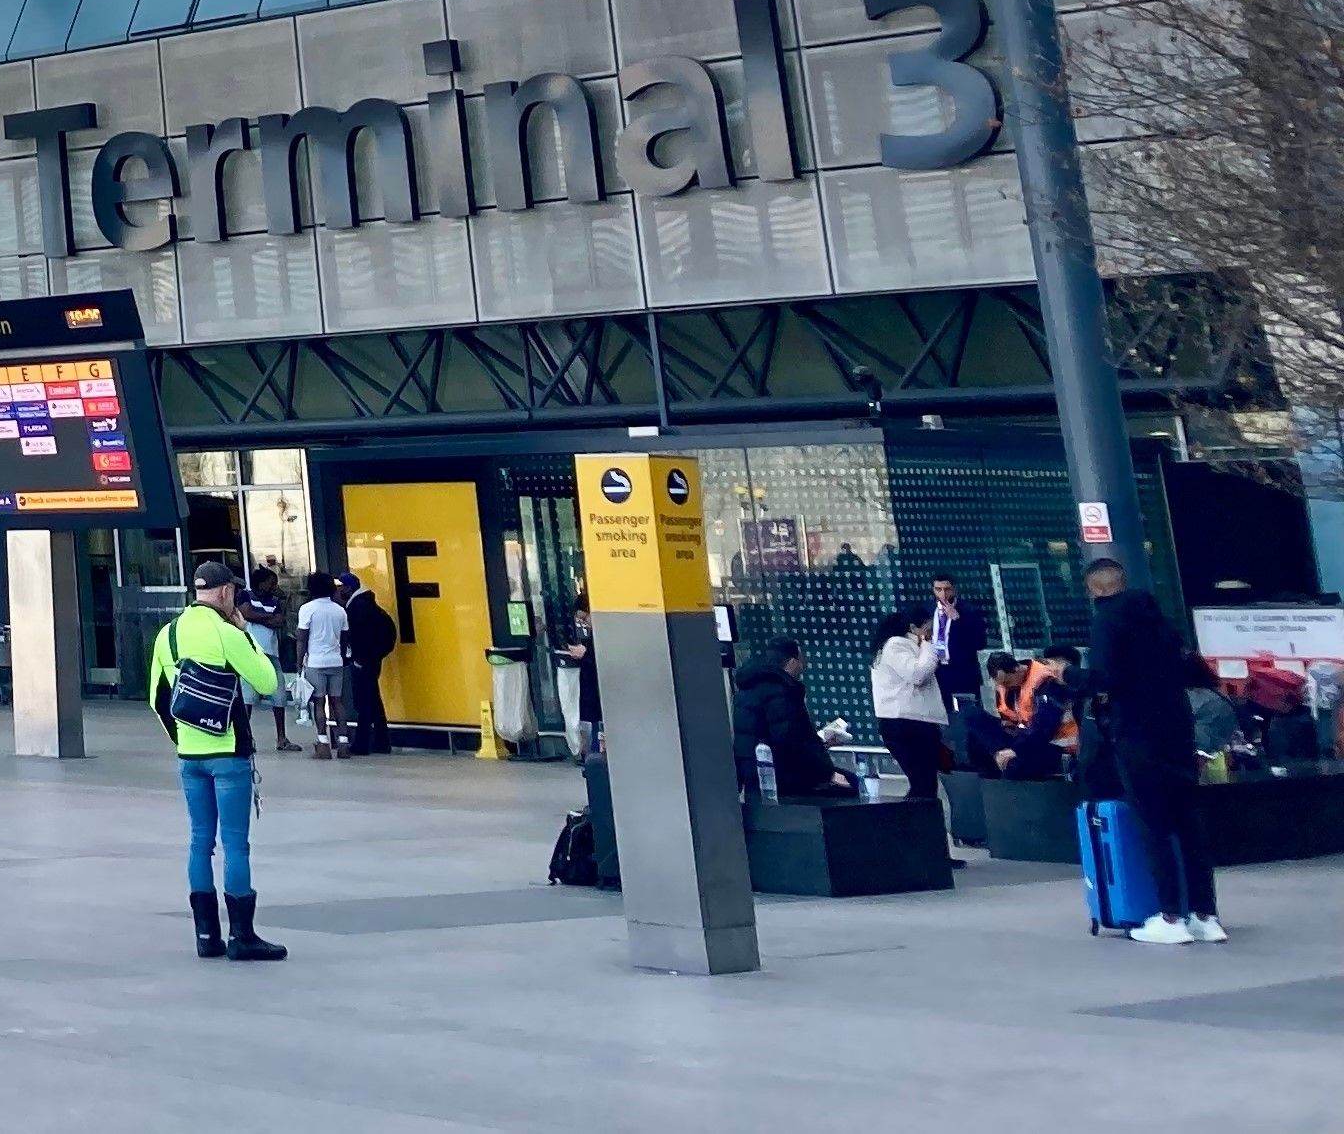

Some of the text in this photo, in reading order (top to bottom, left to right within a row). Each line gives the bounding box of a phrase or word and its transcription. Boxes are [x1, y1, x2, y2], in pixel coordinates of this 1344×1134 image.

[21, 367, 30, 382] E
[56, 365, 64, 379] F
[89, 363, 100, 378] G
[589, 513, 650, 528] Passenger
[659, 513, 702, 529] Passenger
[596, 529, 648, 545] smoking
[665, 530, 701, 547] smoking
[610, 548, 637, 559] area
[675, 548, 695, 560] area
[391, 540, 440, 644] F
[200, 718, 223, 730] FILA
